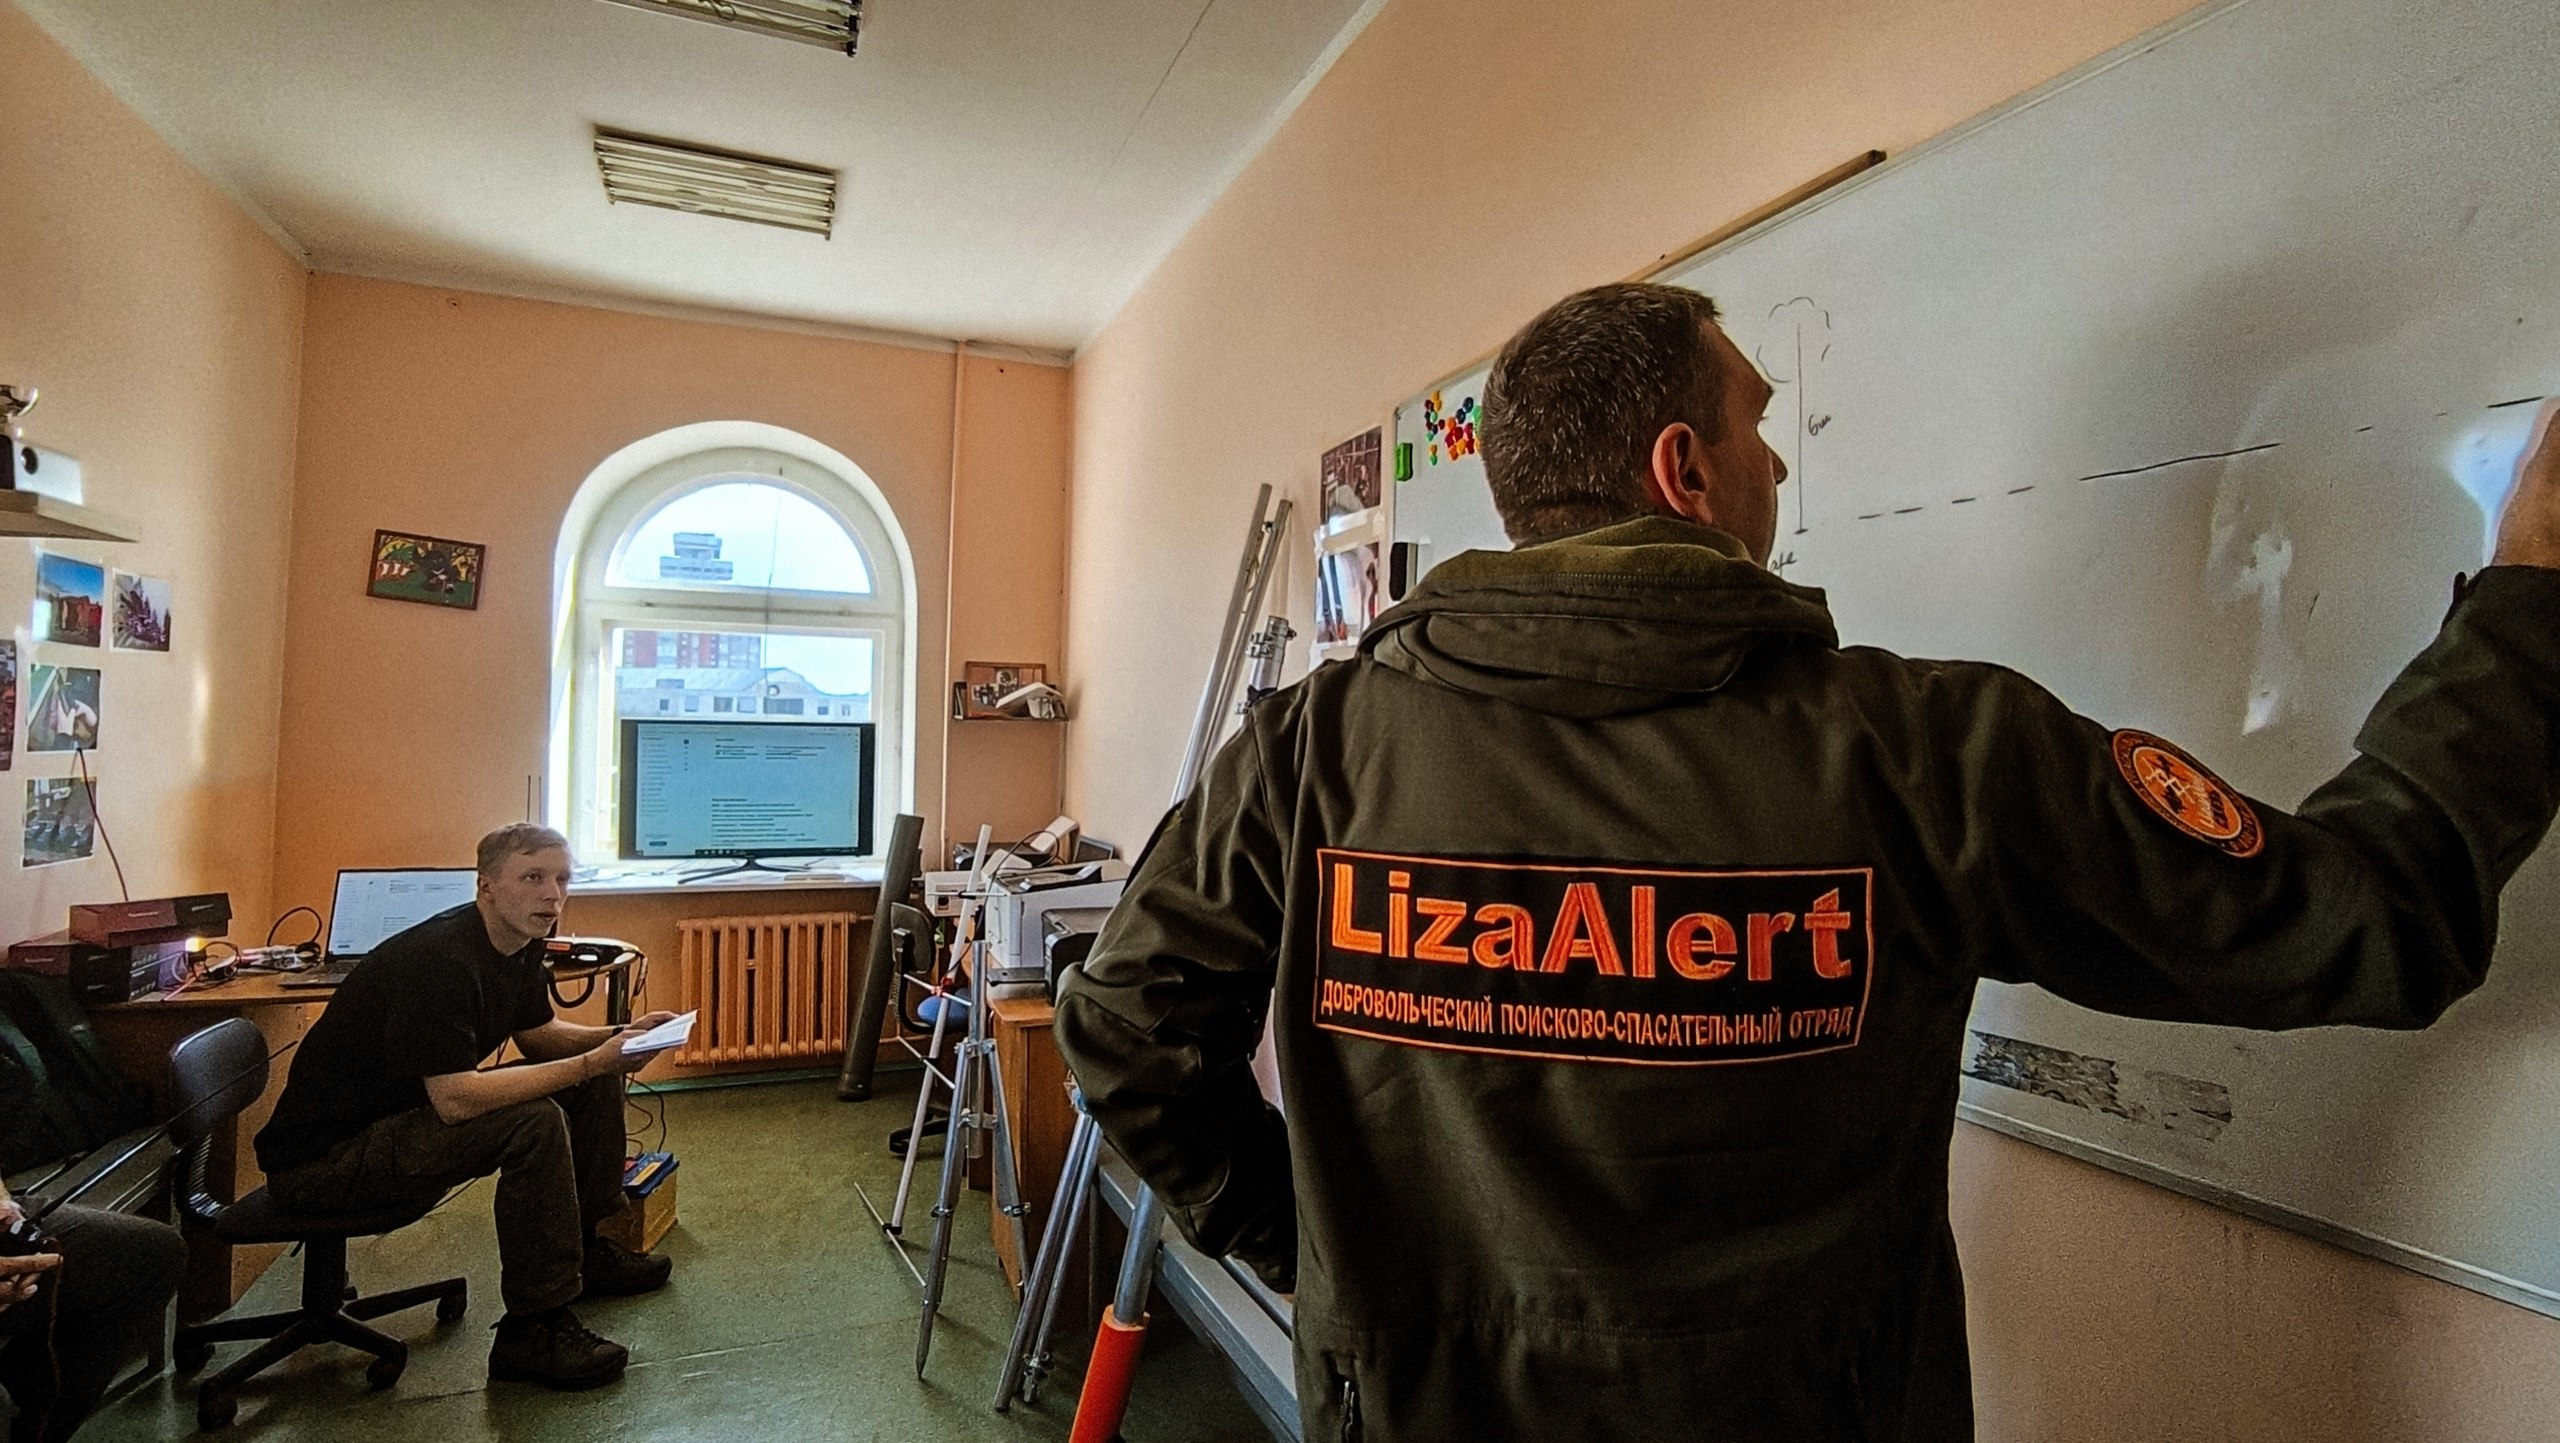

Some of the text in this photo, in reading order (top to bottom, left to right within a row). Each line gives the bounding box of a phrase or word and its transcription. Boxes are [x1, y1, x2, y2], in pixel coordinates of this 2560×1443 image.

[1331, 863, 1851, 980] LizaAlert
[1321, 979, 1855, 1046] ДОБРОВОЛЬЧЕСКИЙ ПОИСКОВО-СПАСАТЕЛЬНЫЙ ОТРЯД
